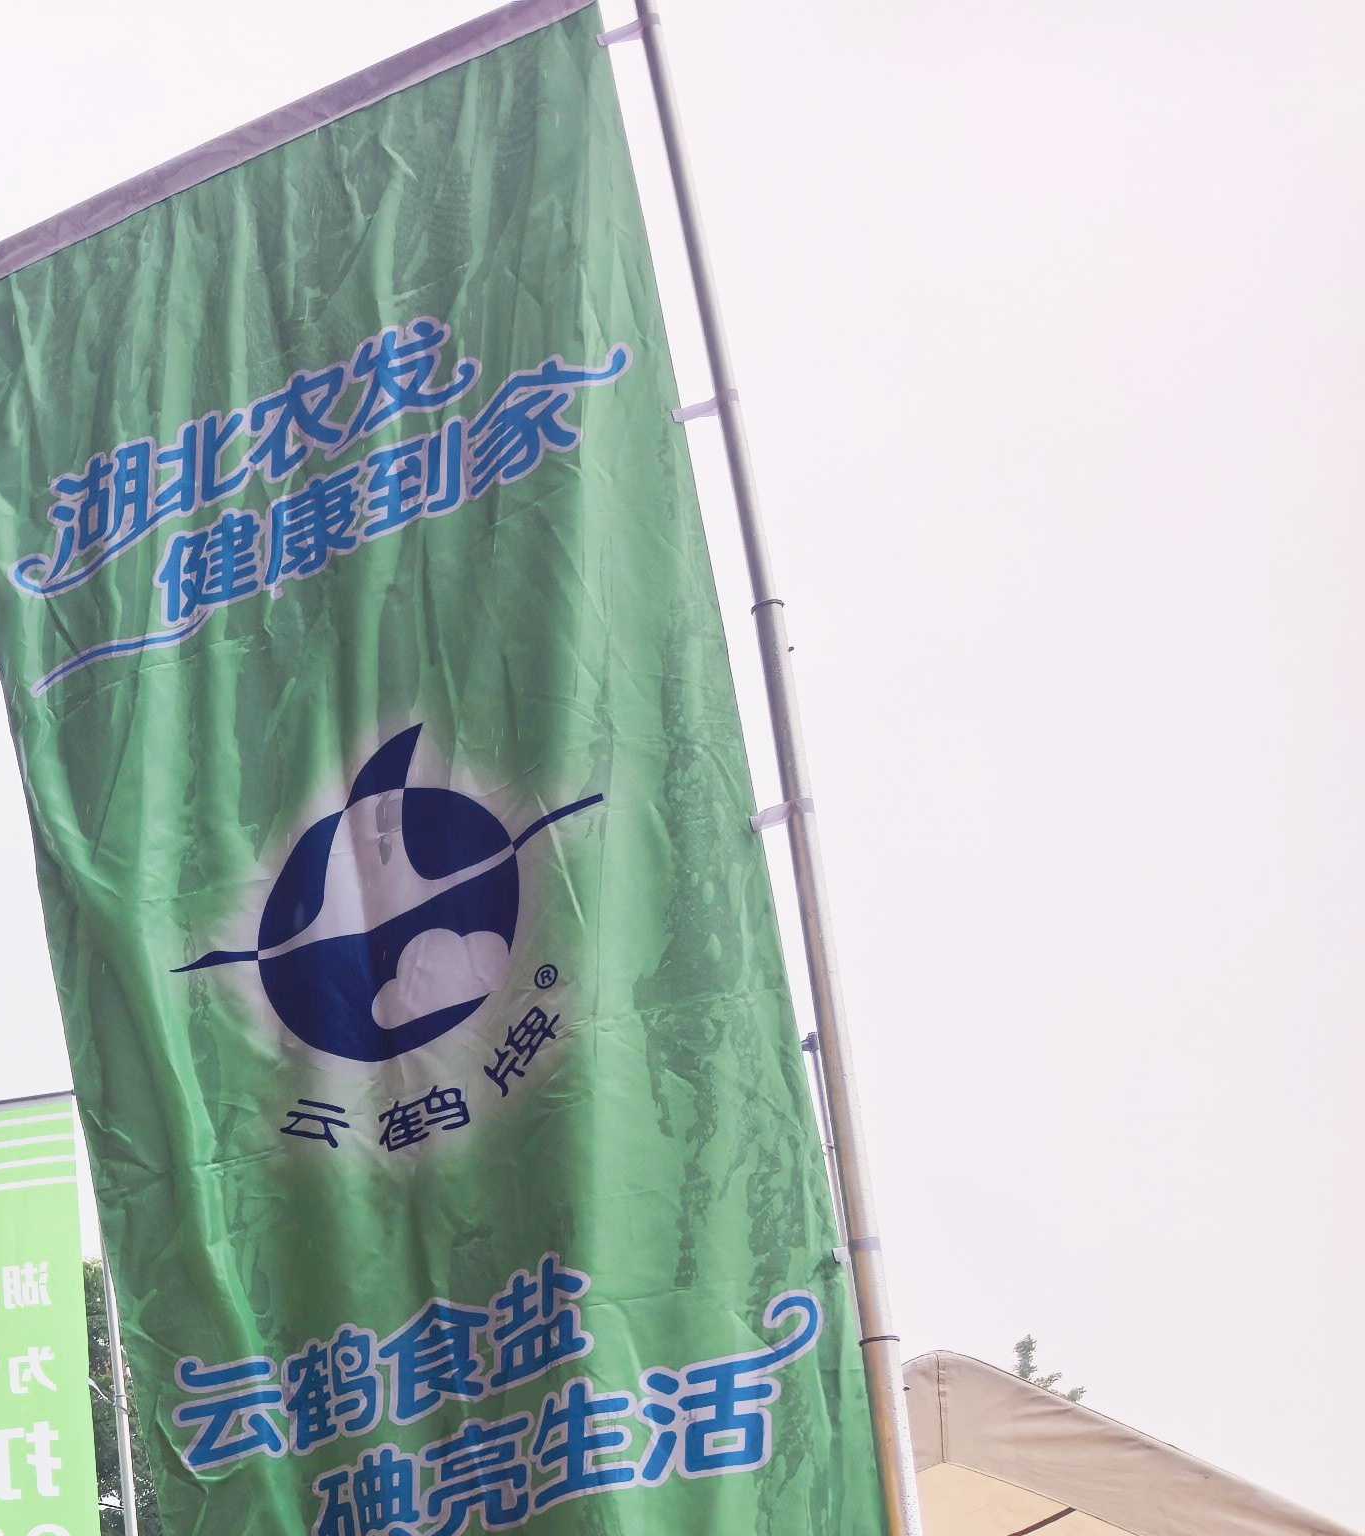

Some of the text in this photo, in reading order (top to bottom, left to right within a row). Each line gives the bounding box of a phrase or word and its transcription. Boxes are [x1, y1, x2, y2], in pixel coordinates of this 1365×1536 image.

[11, 316, 479, 597] 湖北农发
[159, 343, 631, 625] 健康到家
[279, 1006, 563, 1152] 云鹤牌
[173, 1250, 591, 1469] 云鹤食盐
